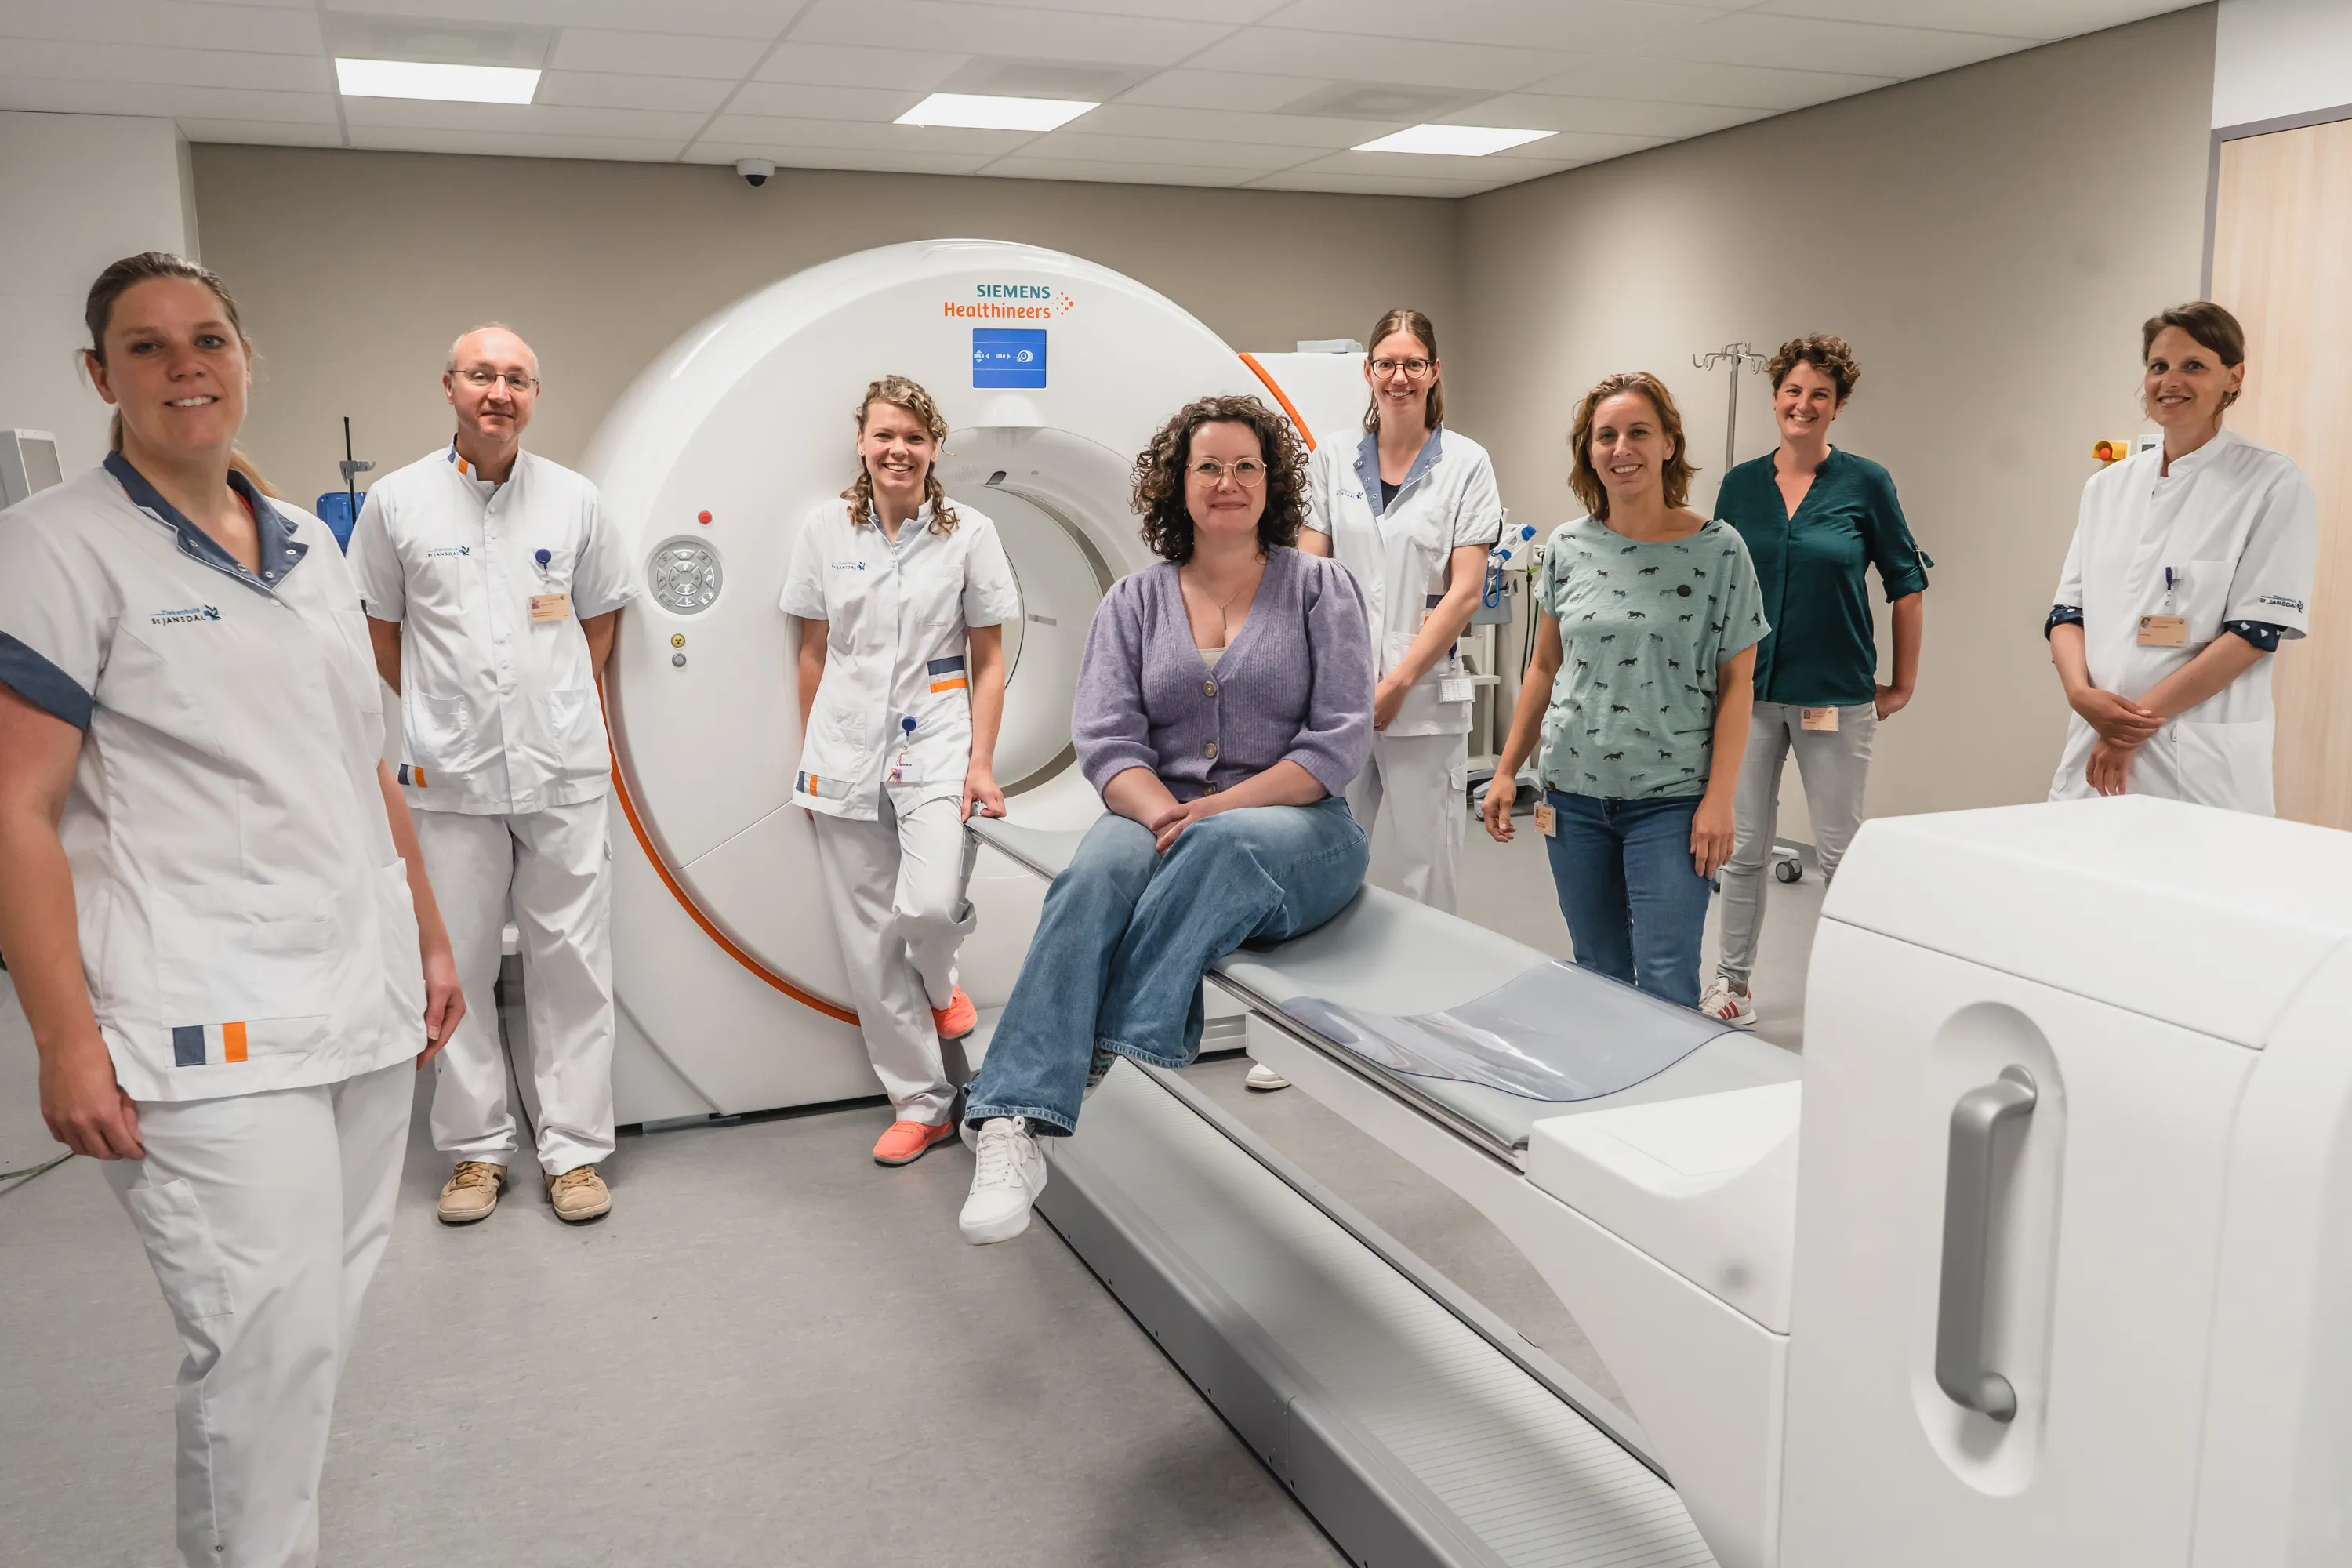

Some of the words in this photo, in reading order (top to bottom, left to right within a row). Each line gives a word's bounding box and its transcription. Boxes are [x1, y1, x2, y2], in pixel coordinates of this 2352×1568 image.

[977, 285, 1051, 299] SIEMENS
[944, 302, 1051, 319] Healthineers
[162, 614, 207, 626] JANSDAL
